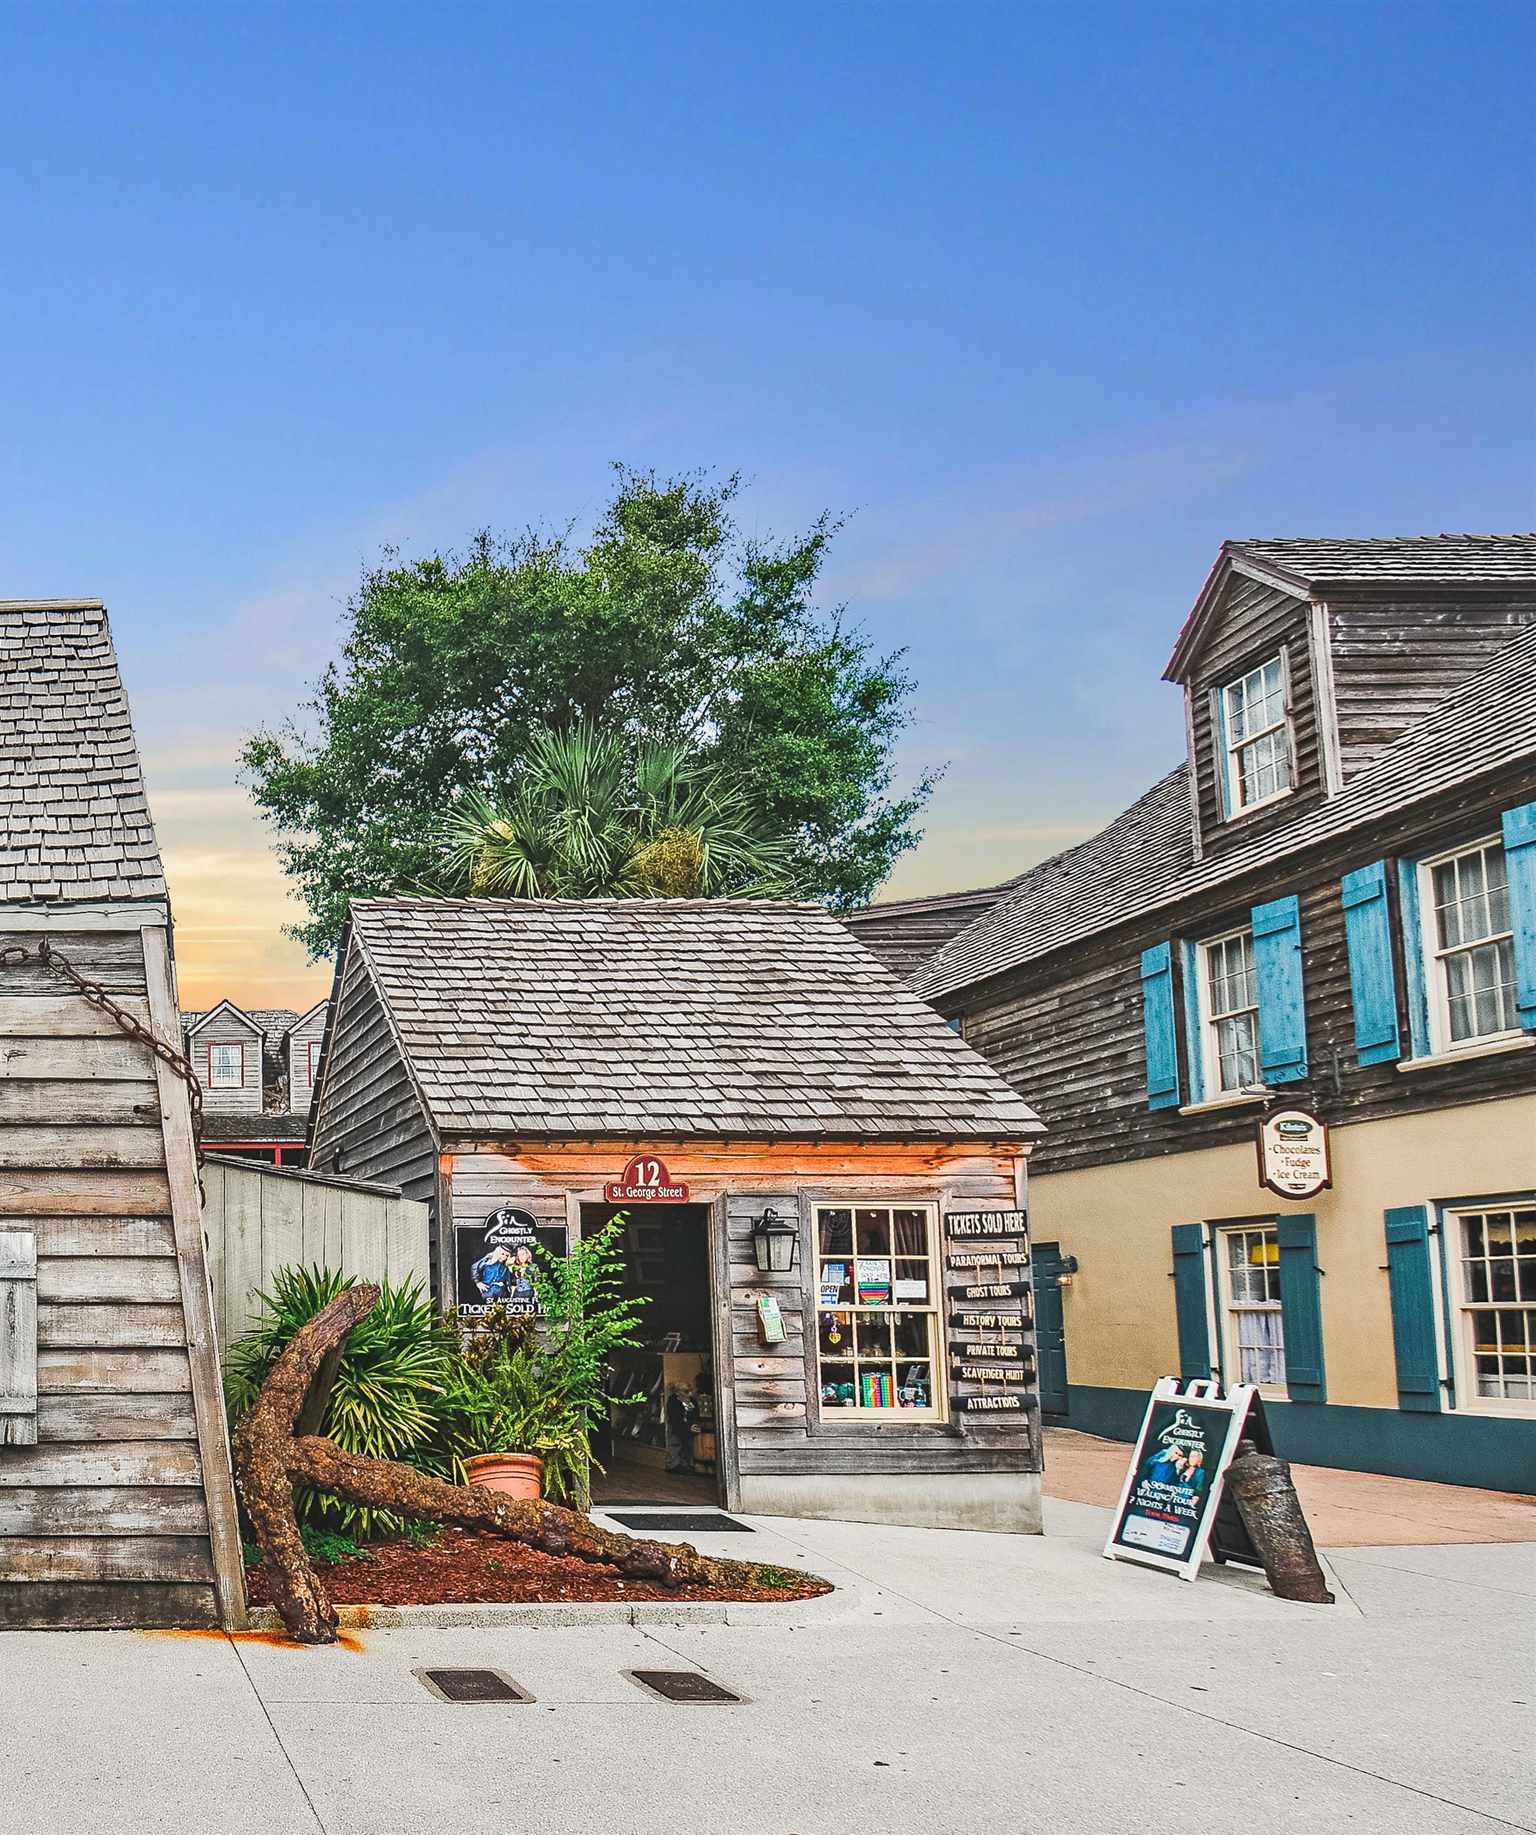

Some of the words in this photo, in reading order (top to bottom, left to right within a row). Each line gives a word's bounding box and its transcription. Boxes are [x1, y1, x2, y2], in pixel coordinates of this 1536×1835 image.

[1273, 1144, 1320, 1154] Chocolates
[1285, 1157, 1311, 1167] Fudge
[635, 1161, 660, 1186] 12
[1277, 1169, 1290, 1179] Ice
[1293, 1170, 1320, 1179] Cream
[612, 1186, 624, 1197] St.
[626, 1186, 656, 1200] George
[658, 1186, 683, 1197] Street
[948, 1213, 981, 1235] TICKETS
[982, 1213, 1003, 1233] SOLD
[1004, 1212, 1025, 1232] HERE
[499, 1227, 533, 1235] GHOSTLY
[490, 1236, 537, 1244] ENCOUNTER
[951, 1254, 1001, 1267] PARANORMAL
[1003, 1253, 1027, 1265] TOURS
[821, 1285, 838, 1293] OPEN
[967, 1287, 988, 1298] GHOST
[989, 1285, 1012, 1296] TOURS
[506, 1303, 535, 1314] SOLD
[963, 1315, 996, 1327] HISTORY
[998, 1316, 1022, 1327] TOURS
[966, 1345, 995, 1356] PRIVATE
[996, 1346, 1018, 1356] TOURS
[962, 1367, 1004, 1379] SCAVENGER
[1005, 1370, 1024, 1380] HUNT
[967, 1396, 1020, 1409] ATTRACTIONS
[1136, 1498, 1163, 1509] NIGHTS
[1163, 1504, 1171, 1512] A
[1174, 1506, 1198, 1520] WEEK
